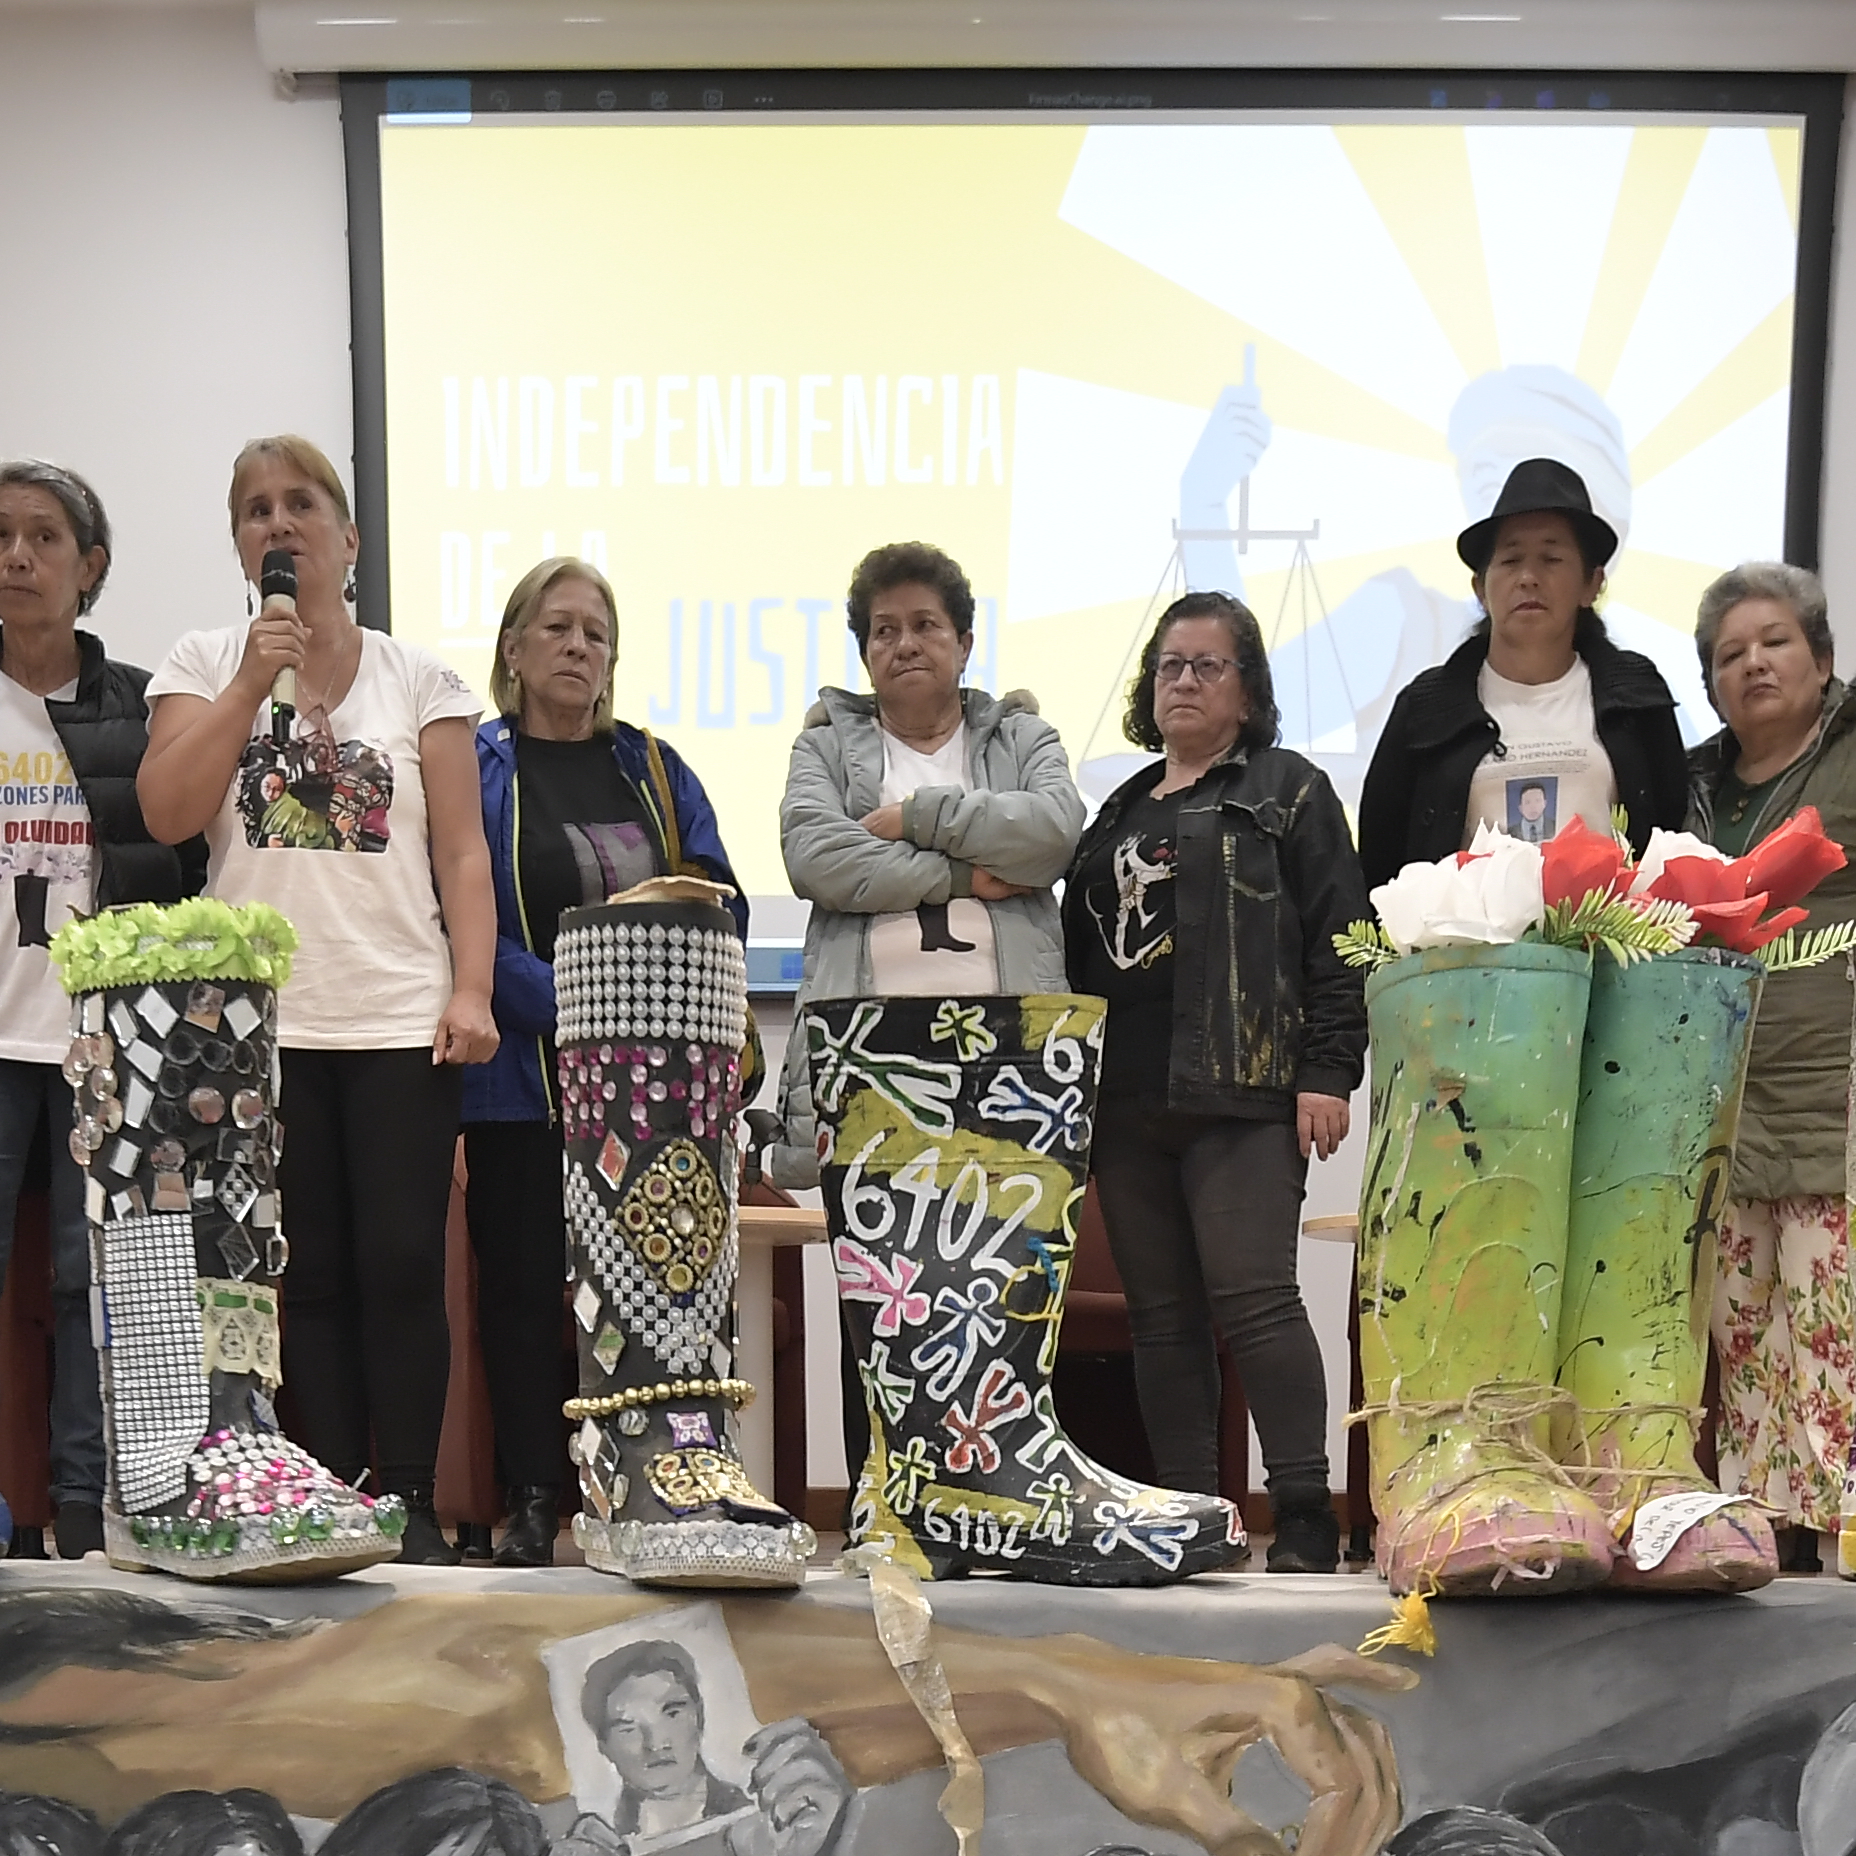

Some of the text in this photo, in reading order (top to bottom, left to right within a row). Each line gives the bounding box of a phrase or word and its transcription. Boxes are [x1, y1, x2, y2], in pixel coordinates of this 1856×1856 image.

[444, 372, 1004, 491] INDEPENDENCIA
[842, 1128, 1029, 1280] 6402
[923, 1497, 1027, 1560] 6402
